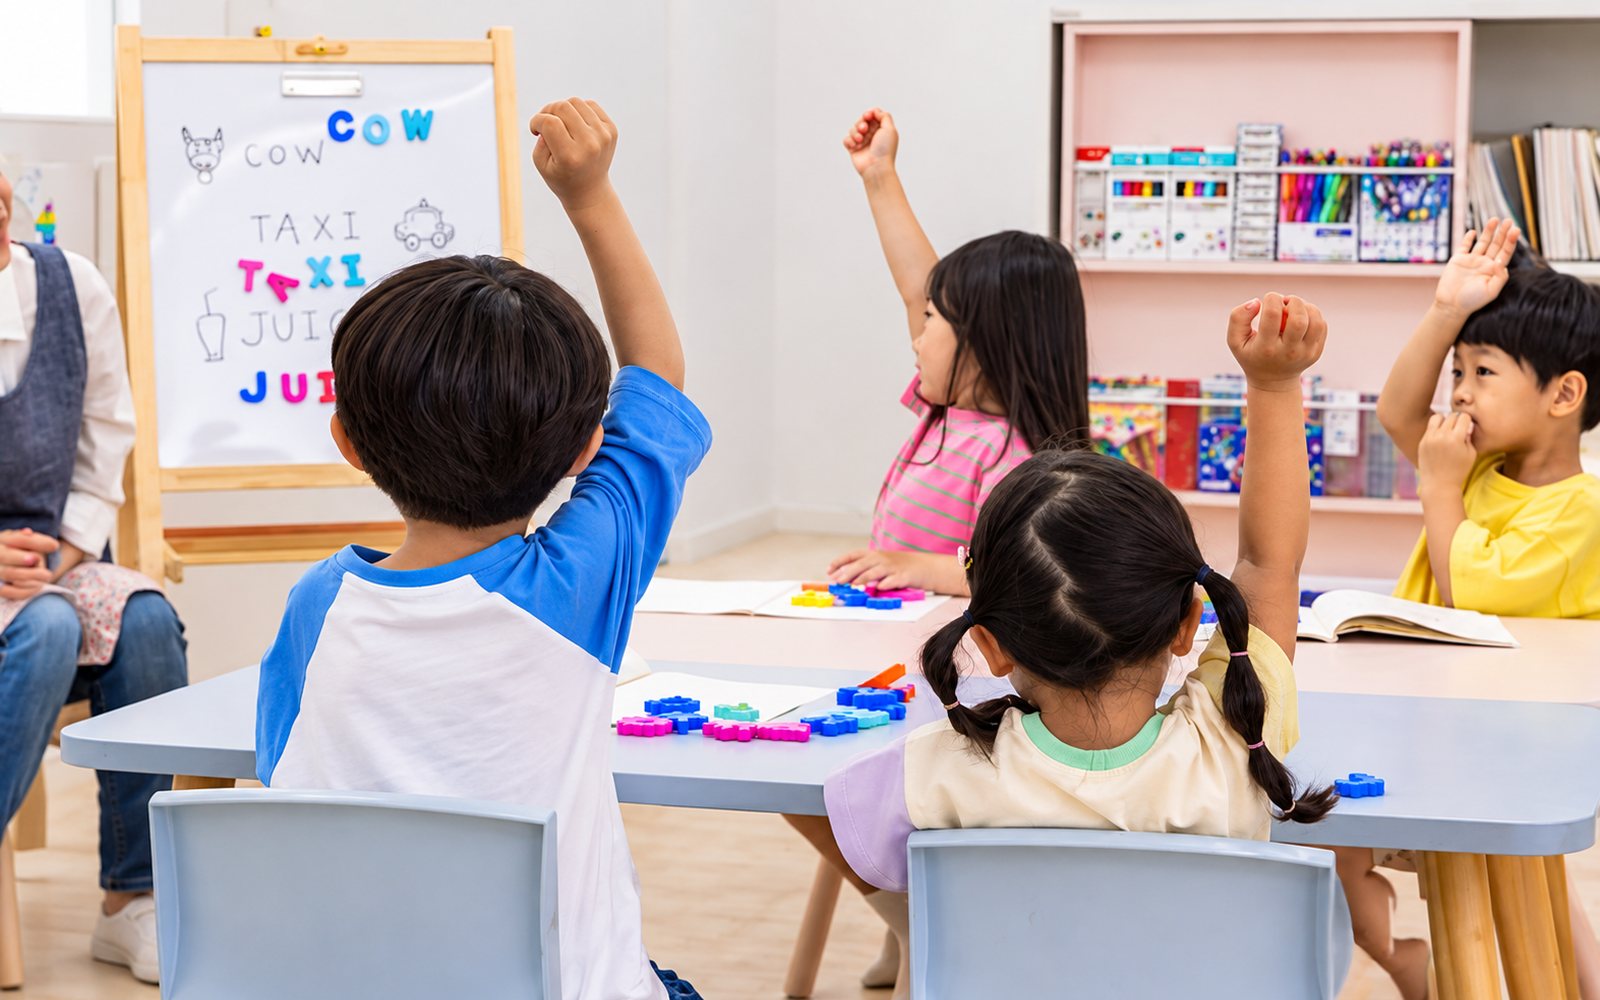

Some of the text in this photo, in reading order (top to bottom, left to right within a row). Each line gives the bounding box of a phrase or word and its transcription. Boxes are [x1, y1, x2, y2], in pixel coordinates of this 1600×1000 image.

[328, 109, 433, 145] COW
[244, 139, 324, 168] COW
[250, 211, 360, 245] TAXI
[238, 254, 366, 303] TAXI
